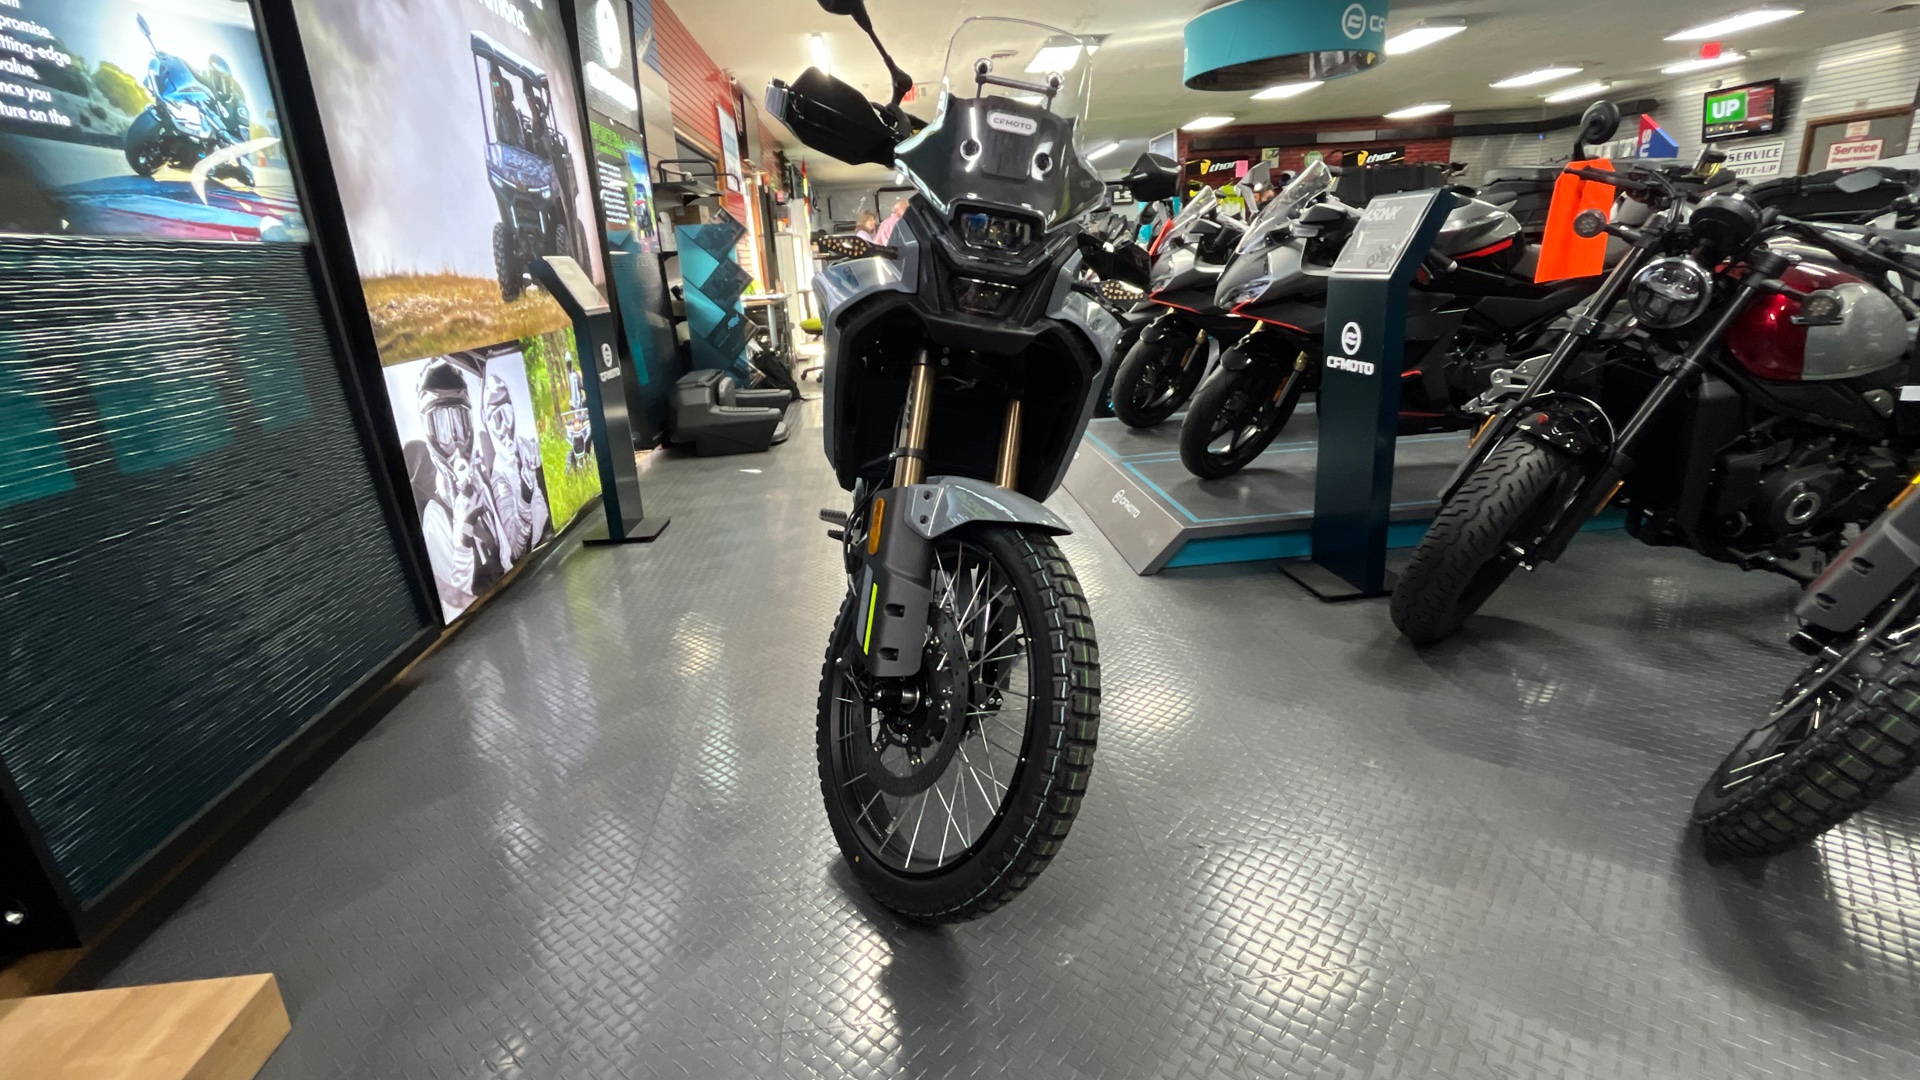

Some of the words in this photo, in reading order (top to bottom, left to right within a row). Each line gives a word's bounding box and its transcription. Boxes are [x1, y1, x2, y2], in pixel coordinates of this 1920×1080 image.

[25, 86, 52, 102] you
[1712, 98, 1740, 119] UP
[29, 109, 48, 123] on
[48, 108, 71, 126] the
[993, 117, 1032, 130] CFMOTO
[1366, 151, 1397, 164] thor
[1728, 147, 1781, 163] SERVICE
[1832, 143, 1878, 156] Service
[1734, 164, 1777, 176] RITE-UP
[1326, 355, 1375, 375] CFMOTO
